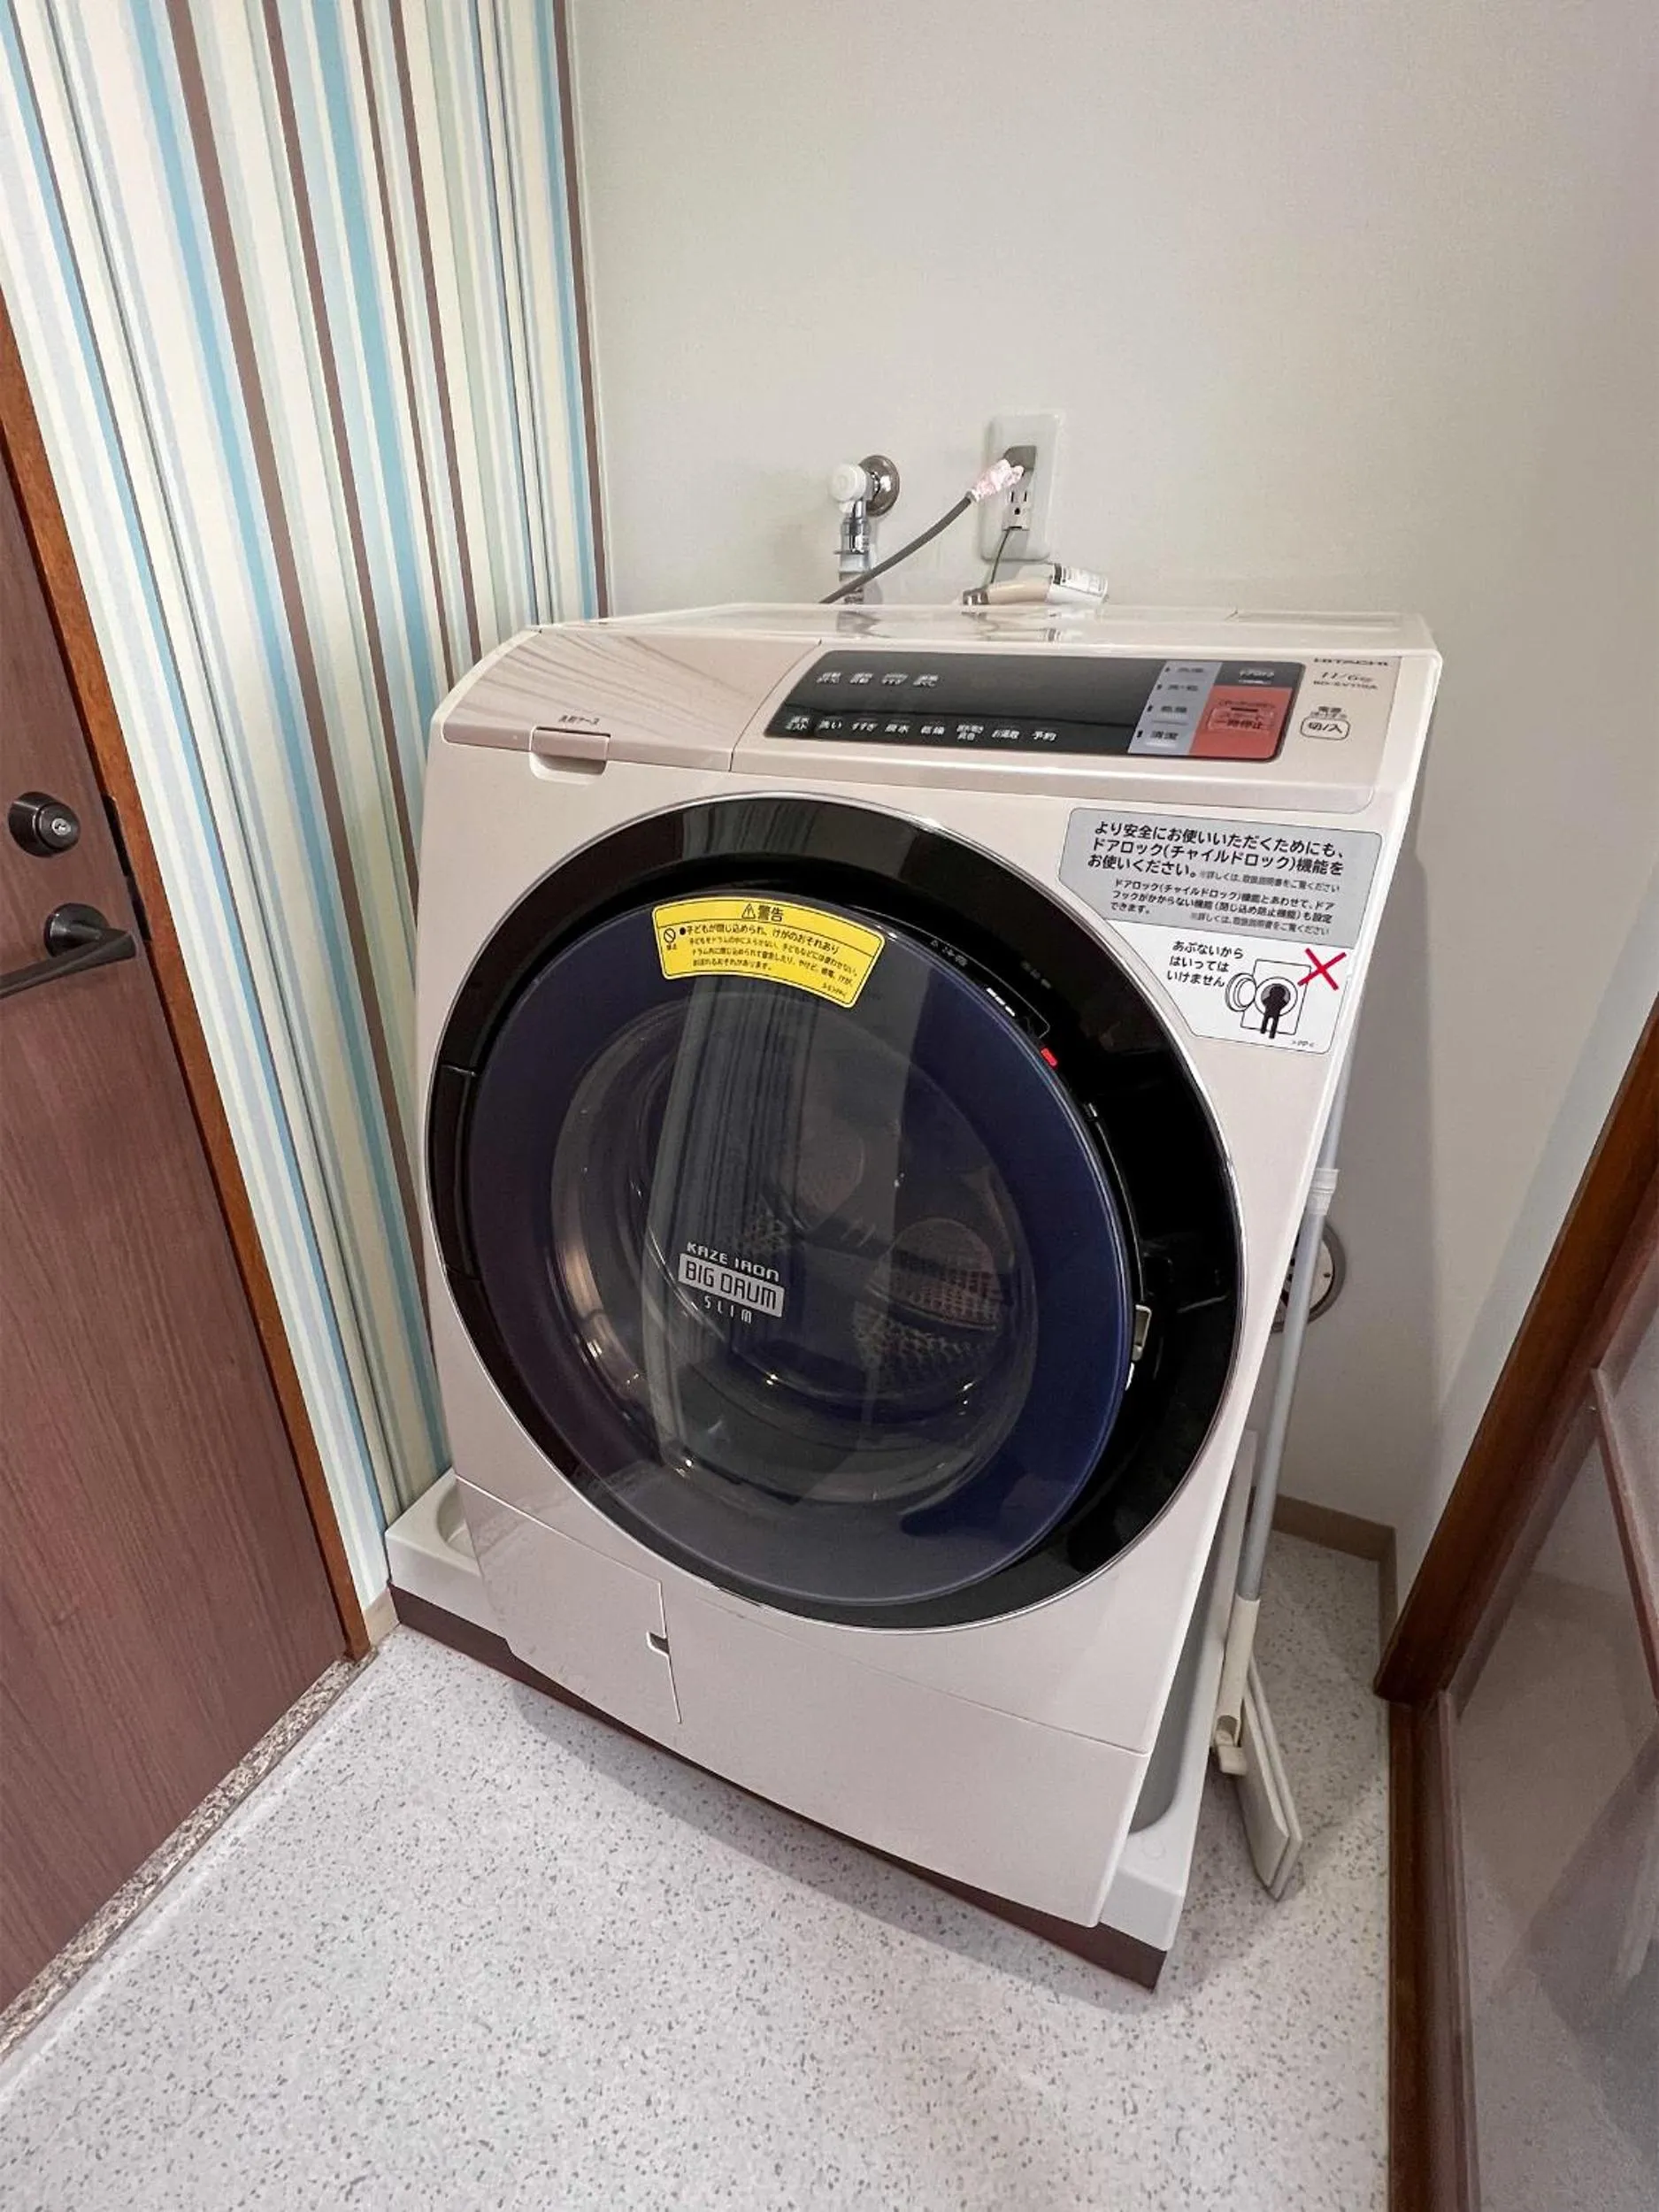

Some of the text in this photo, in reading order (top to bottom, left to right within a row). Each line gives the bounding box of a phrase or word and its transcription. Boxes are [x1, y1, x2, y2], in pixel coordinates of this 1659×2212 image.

[1094, 820, 1344, 859] より安全にお使いいただくためにも、
[1087, 854, 1198, 879] お使いください。
[1093, 838, 1345, 877] ドアロック(チャイルドロック)機能を
[1169, 956, 1230, 972] はいっては
[1172, 941, 1244, 959] あぶないから
[1166, 970, 1225, 988] いけません
[687, 1241, 780, 1282] KAZE IRON
[685, 1260, 777, 1310] BIG DRUM
[704, 1295, 752, 1325] SLIM
